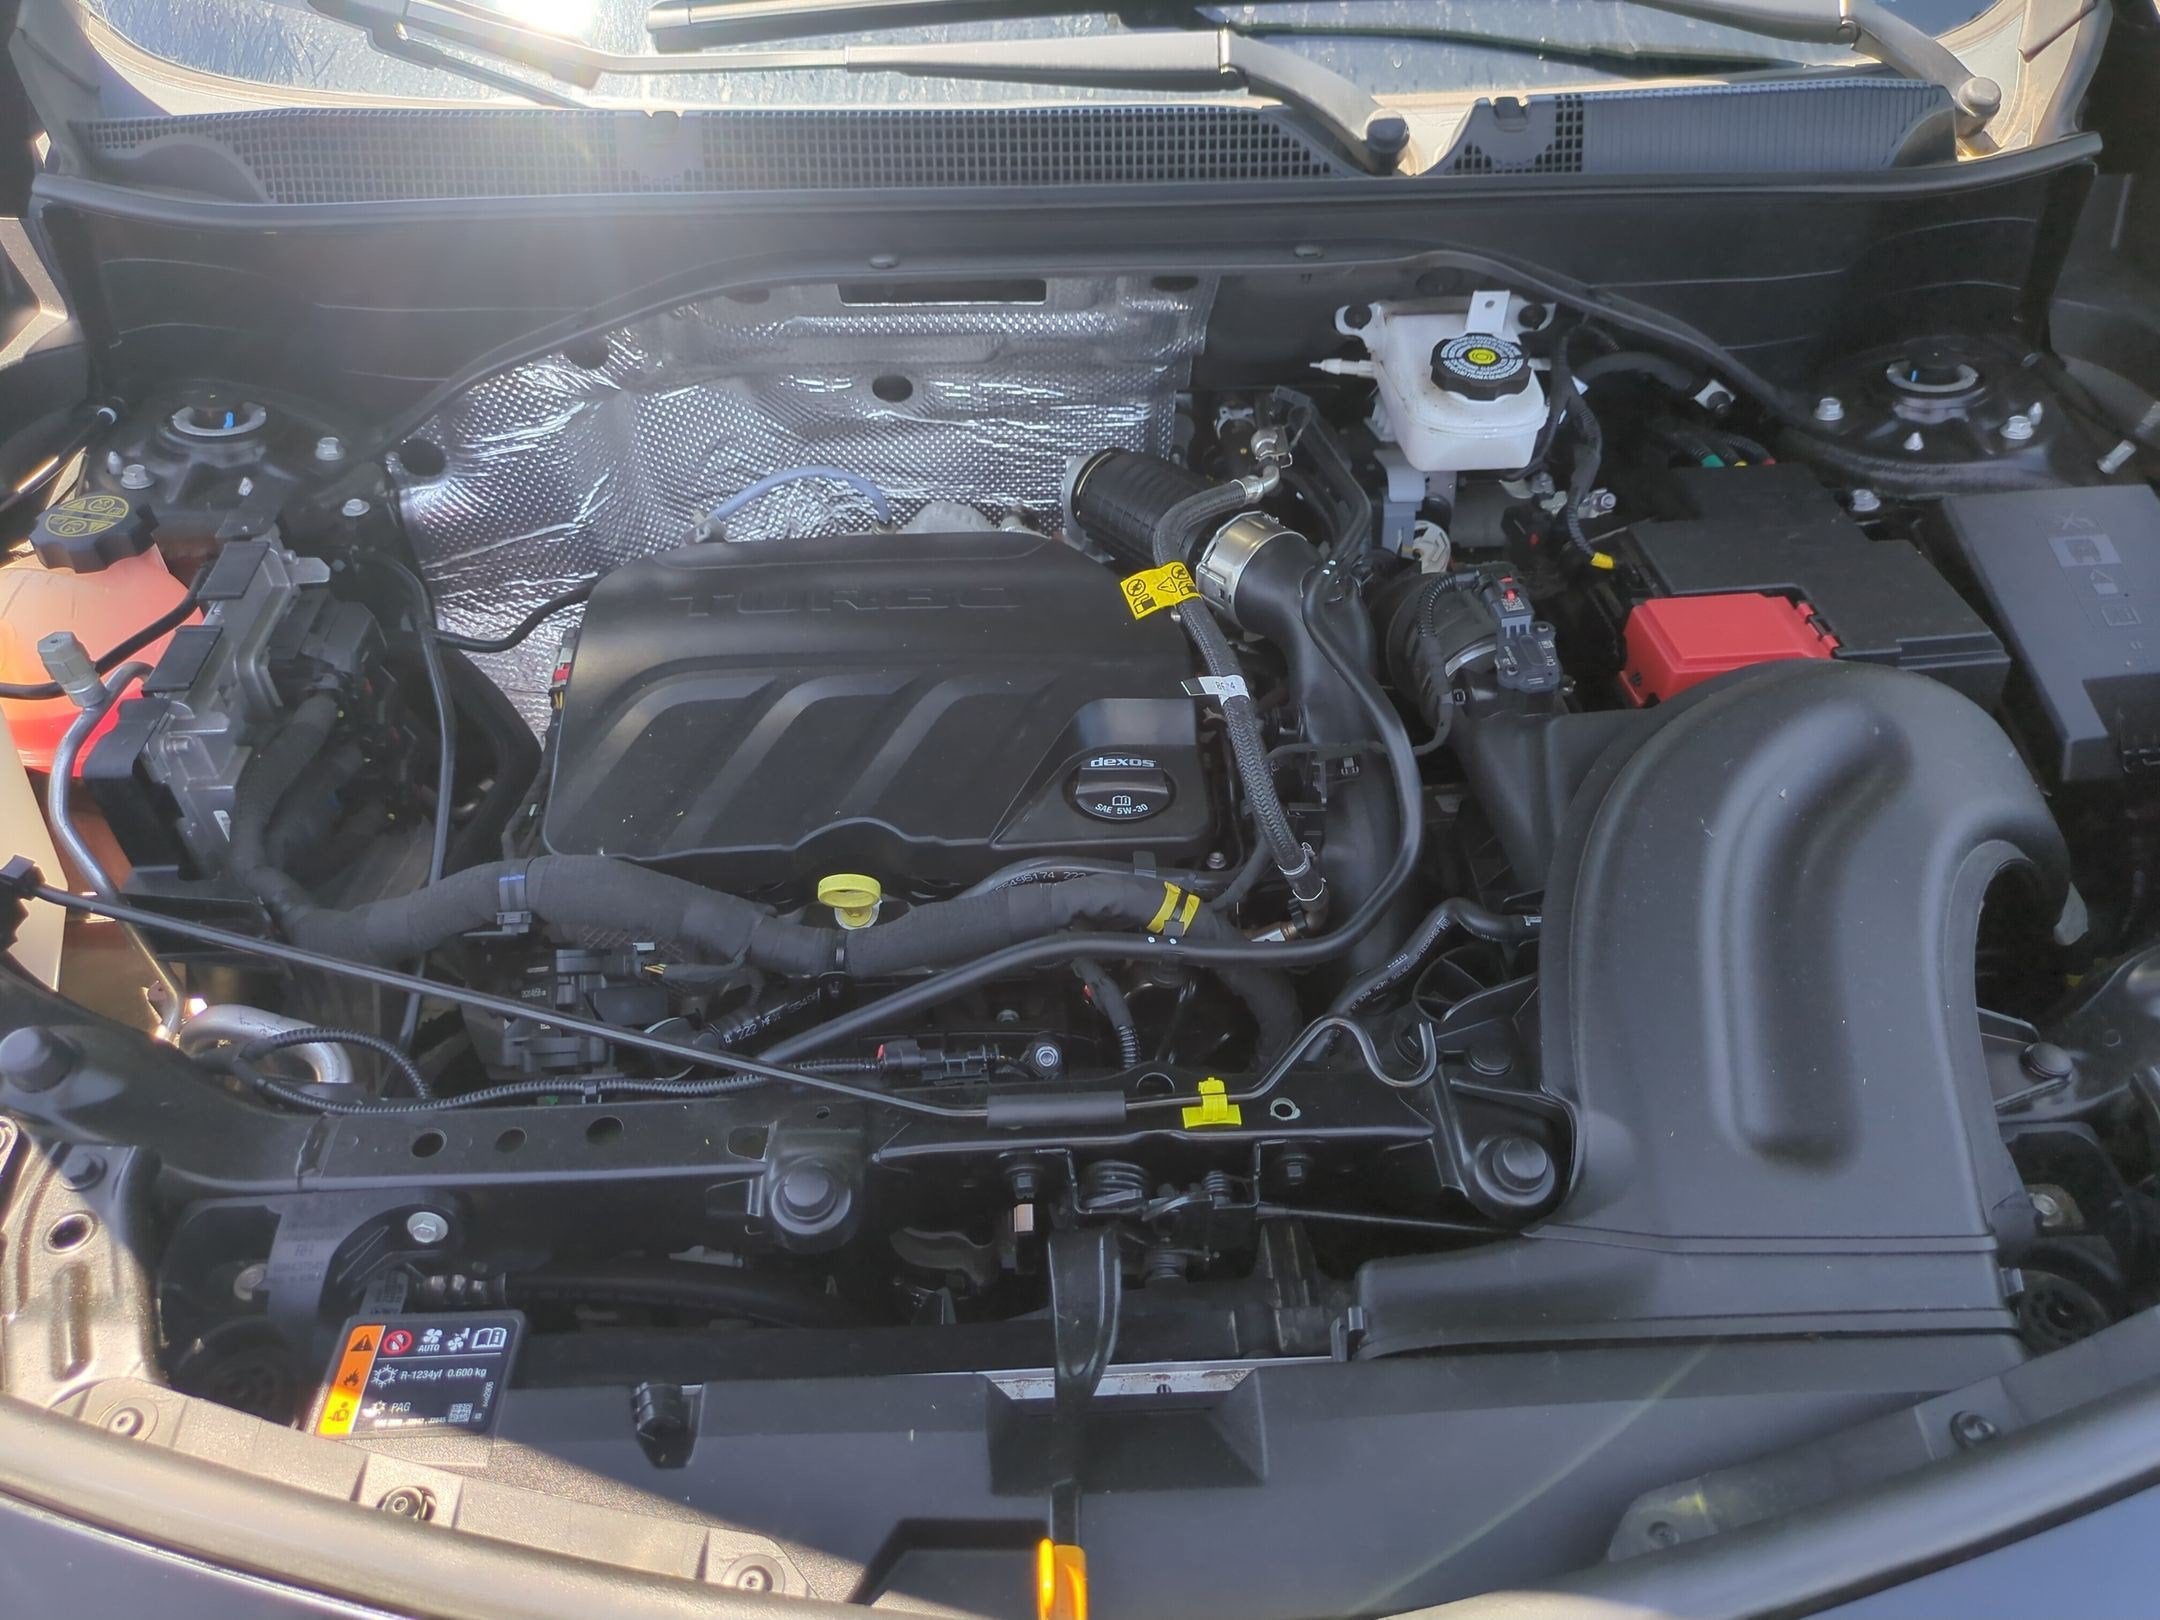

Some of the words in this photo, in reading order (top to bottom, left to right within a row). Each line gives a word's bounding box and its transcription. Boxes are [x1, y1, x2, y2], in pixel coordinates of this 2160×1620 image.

[1090, 757, 1156, 768] dexos
[1095, 803, 1113, 814] SAE
[1116, 803, 1148, 815] 5W-30
[417, 1343, 440, 1352] AUTO
[400, 1368, 443, 1380] R-1234yf
[447, 1367, 474, 1377] 0.600
[474, 1367, 487, 1378] kg
[391, 1401, 411, 1413] PAG
